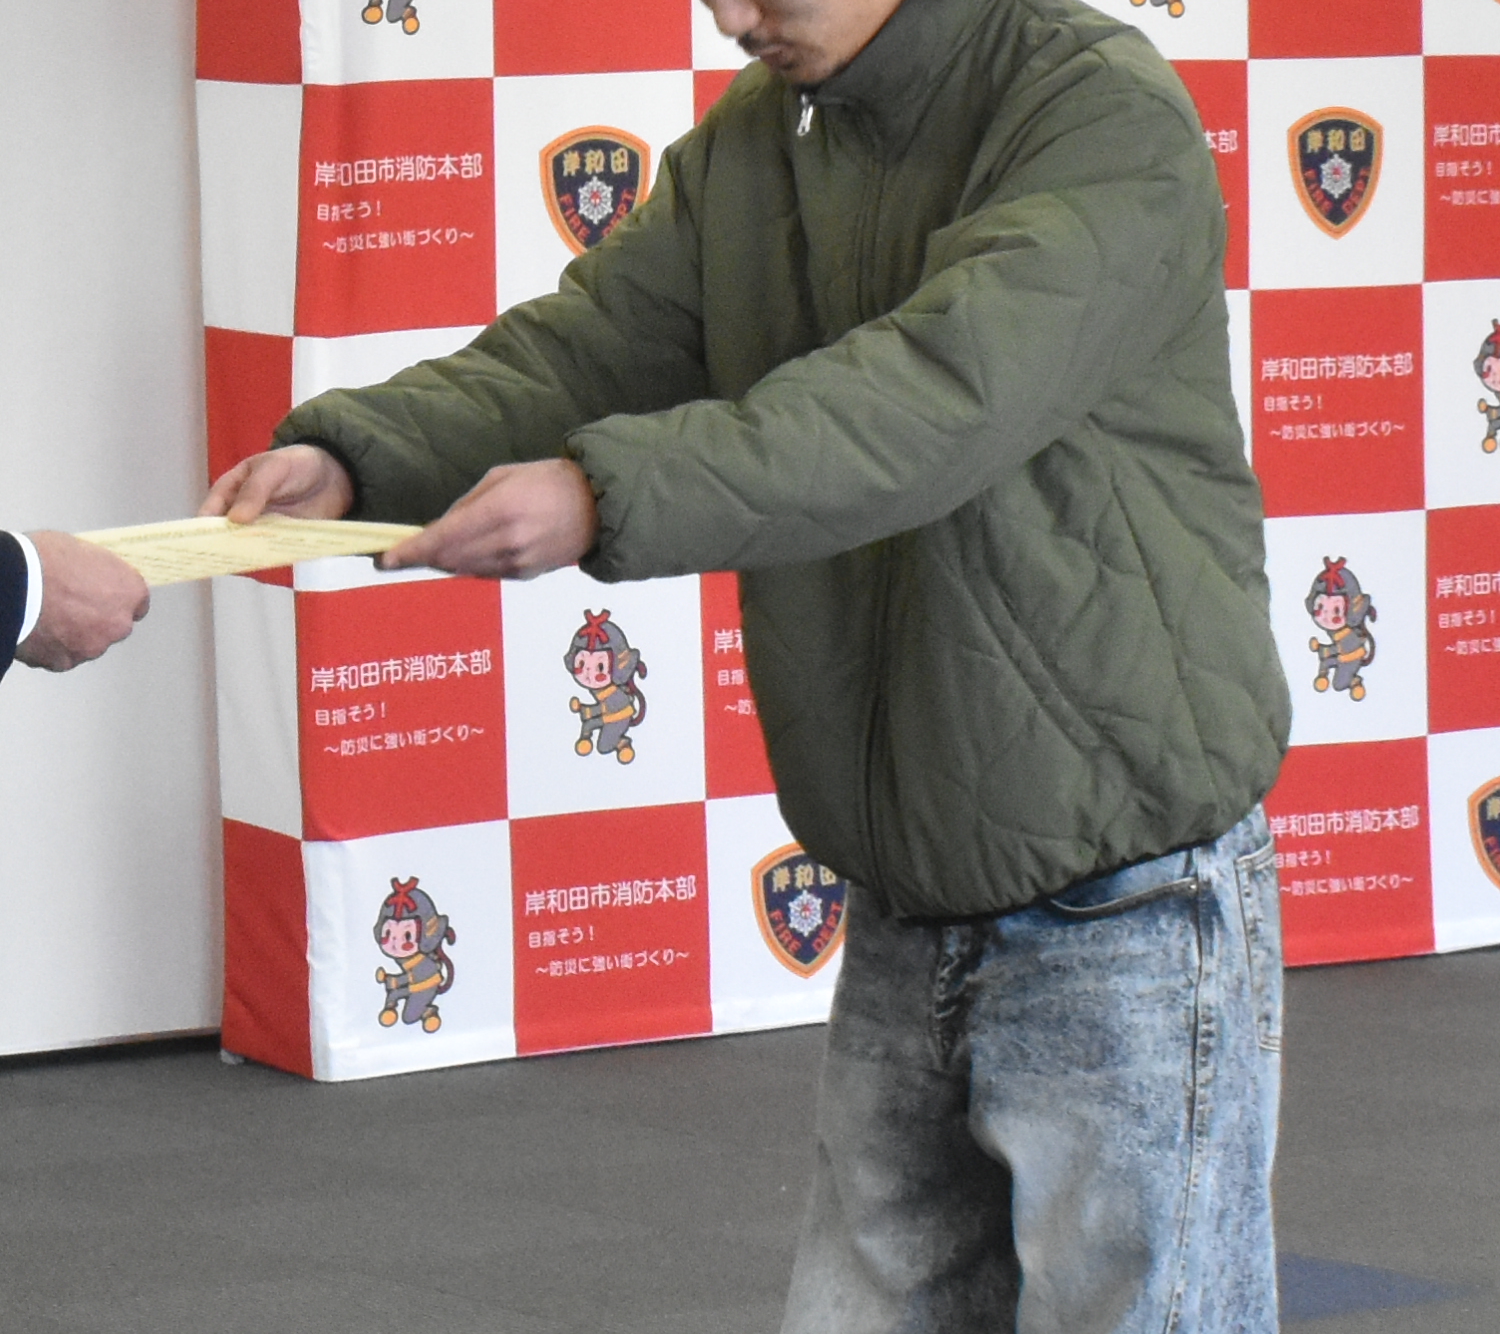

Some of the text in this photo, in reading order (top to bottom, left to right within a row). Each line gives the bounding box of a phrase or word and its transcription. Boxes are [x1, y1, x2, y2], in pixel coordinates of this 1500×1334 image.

[314, 153, 483, 188] 岸和田市消防本部
[1261, 351, 1413, 382] 岸和田市消防本部
[310, 649, 491, 693] 岸和田市消防本部
[315, 702, 386, 726] 目指そう！
[1270, 805, 1419, 838] 岸和田市消防本部
[525, 874, 697, 916] 岸和田市消防本部
[528, 925, 595, 949] 目指そう！
